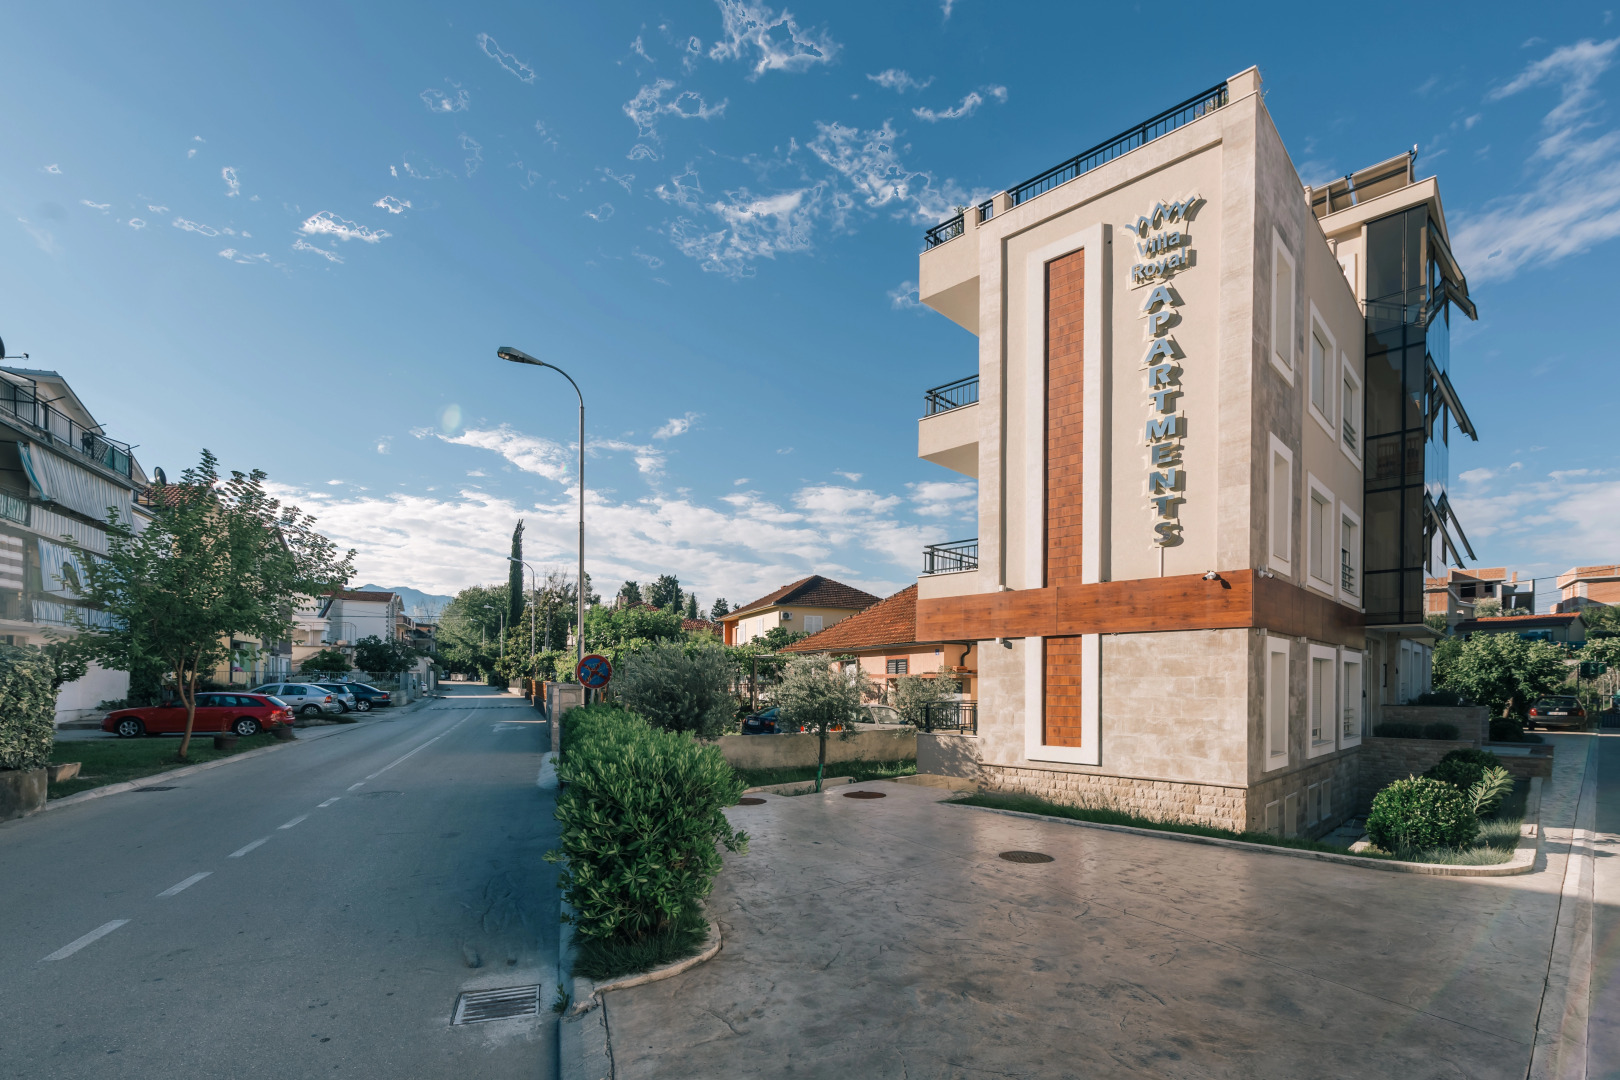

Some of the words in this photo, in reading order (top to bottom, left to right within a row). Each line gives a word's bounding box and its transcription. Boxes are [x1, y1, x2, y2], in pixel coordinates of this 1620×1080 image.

[1136, 231, 1180, 257] Villa
[1130, 246, 1186, 282] Royal
[1144, 284, 1177, 544] APARTMENTS
